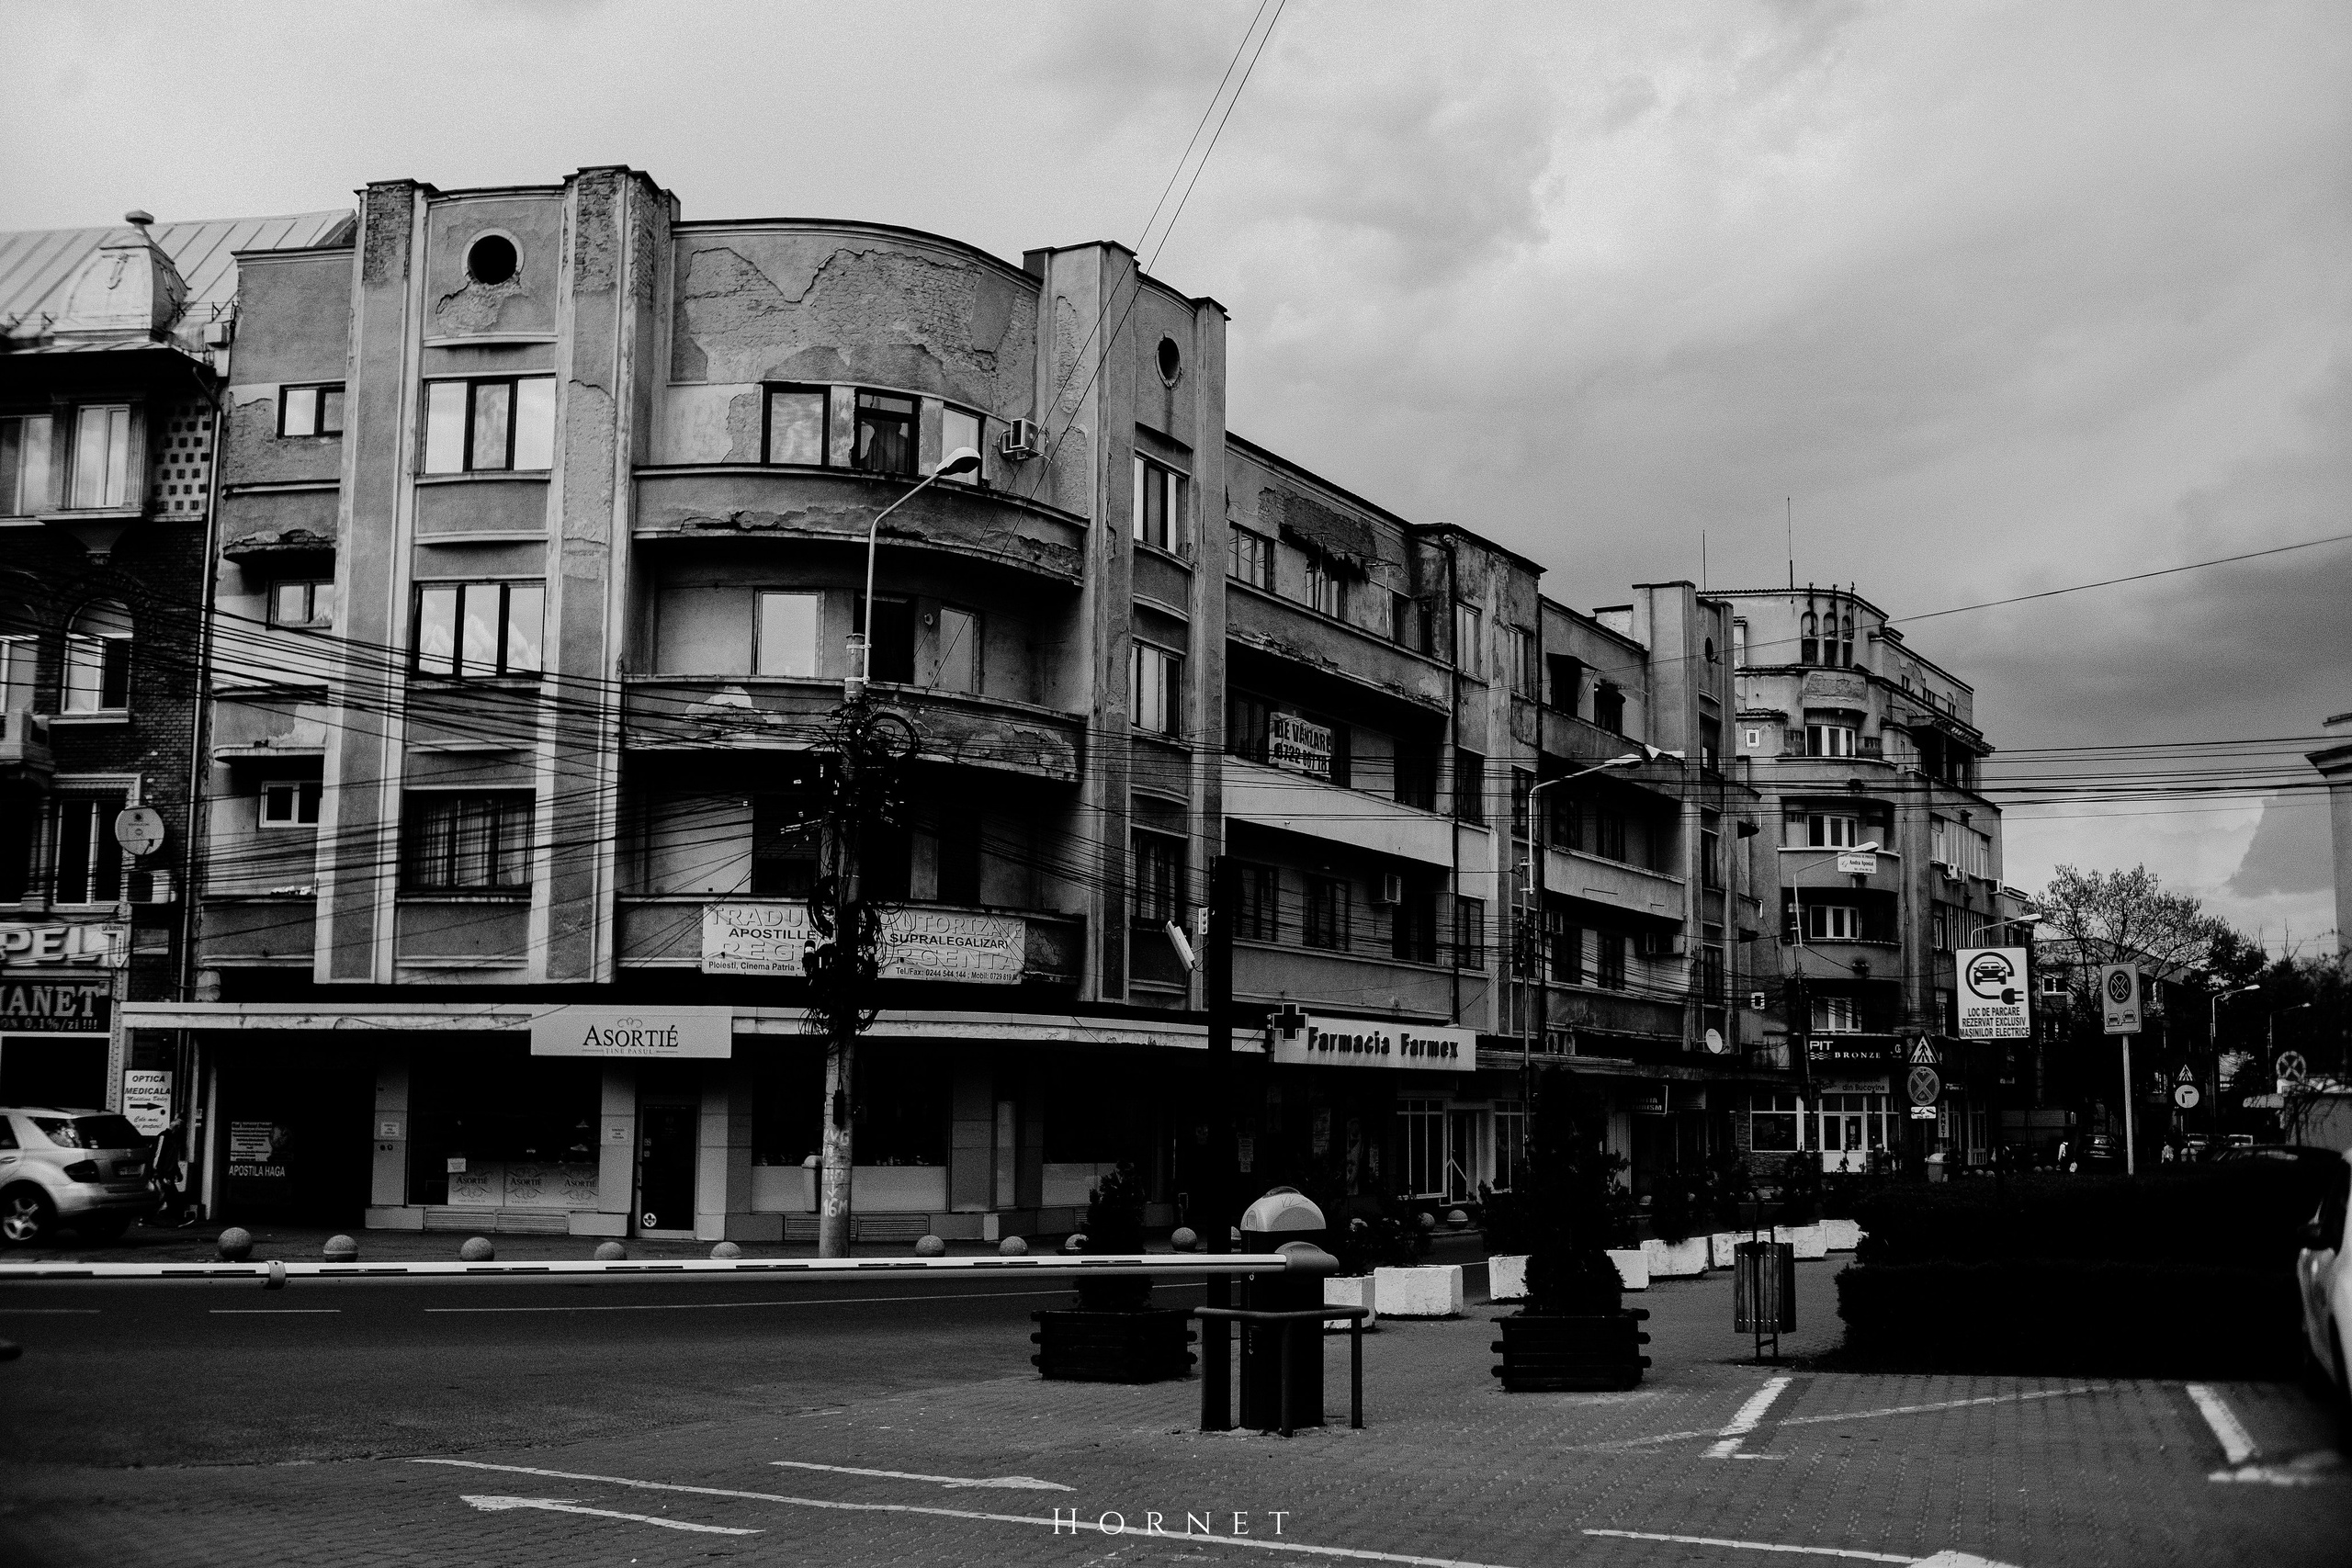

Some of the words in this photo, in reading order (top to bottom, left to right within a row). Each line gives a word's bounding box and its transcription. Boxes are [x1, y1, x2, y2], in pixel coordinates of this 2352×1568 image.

[1274, 720, 1290, 740] DE
[1292, 723, 1330, 752] VÂNZARE
[729, 928, 817, 941] APOSTILLE
[889, 933, 1009, 950] SUPRALEGALIZARI
[741, 963, 770, 971] Cinema
[772, 964, 795, 972] Patria
[971, 972, 989, 980] Mobil:
[1968, 1007, 1980, 1017] LOC
[1982, 1007, 1990, 1016] DE
[1992, 1007, 2020, 1016] PARCARE
[1962, 1017, 1994, 1027] REZERVAT
[1996, 1017, 2026, 1026] EXCLUSIV
[582, 1024, 679, 1047] ASORTIÉ
[1996, 1027, 2030, 1036] ELECTRICE
[1307, 1027, 1390, 1055] Farmacia
[1401, 1033, 1459, 1057] Farmex
[1809, 1041, 1834, 1051] PIT
[1834, 1052, 1881, 1060] BRONZE
[229, 1165, 264, 1177] APOSTILA
[265, 1166, 286, 1177] HAGA
